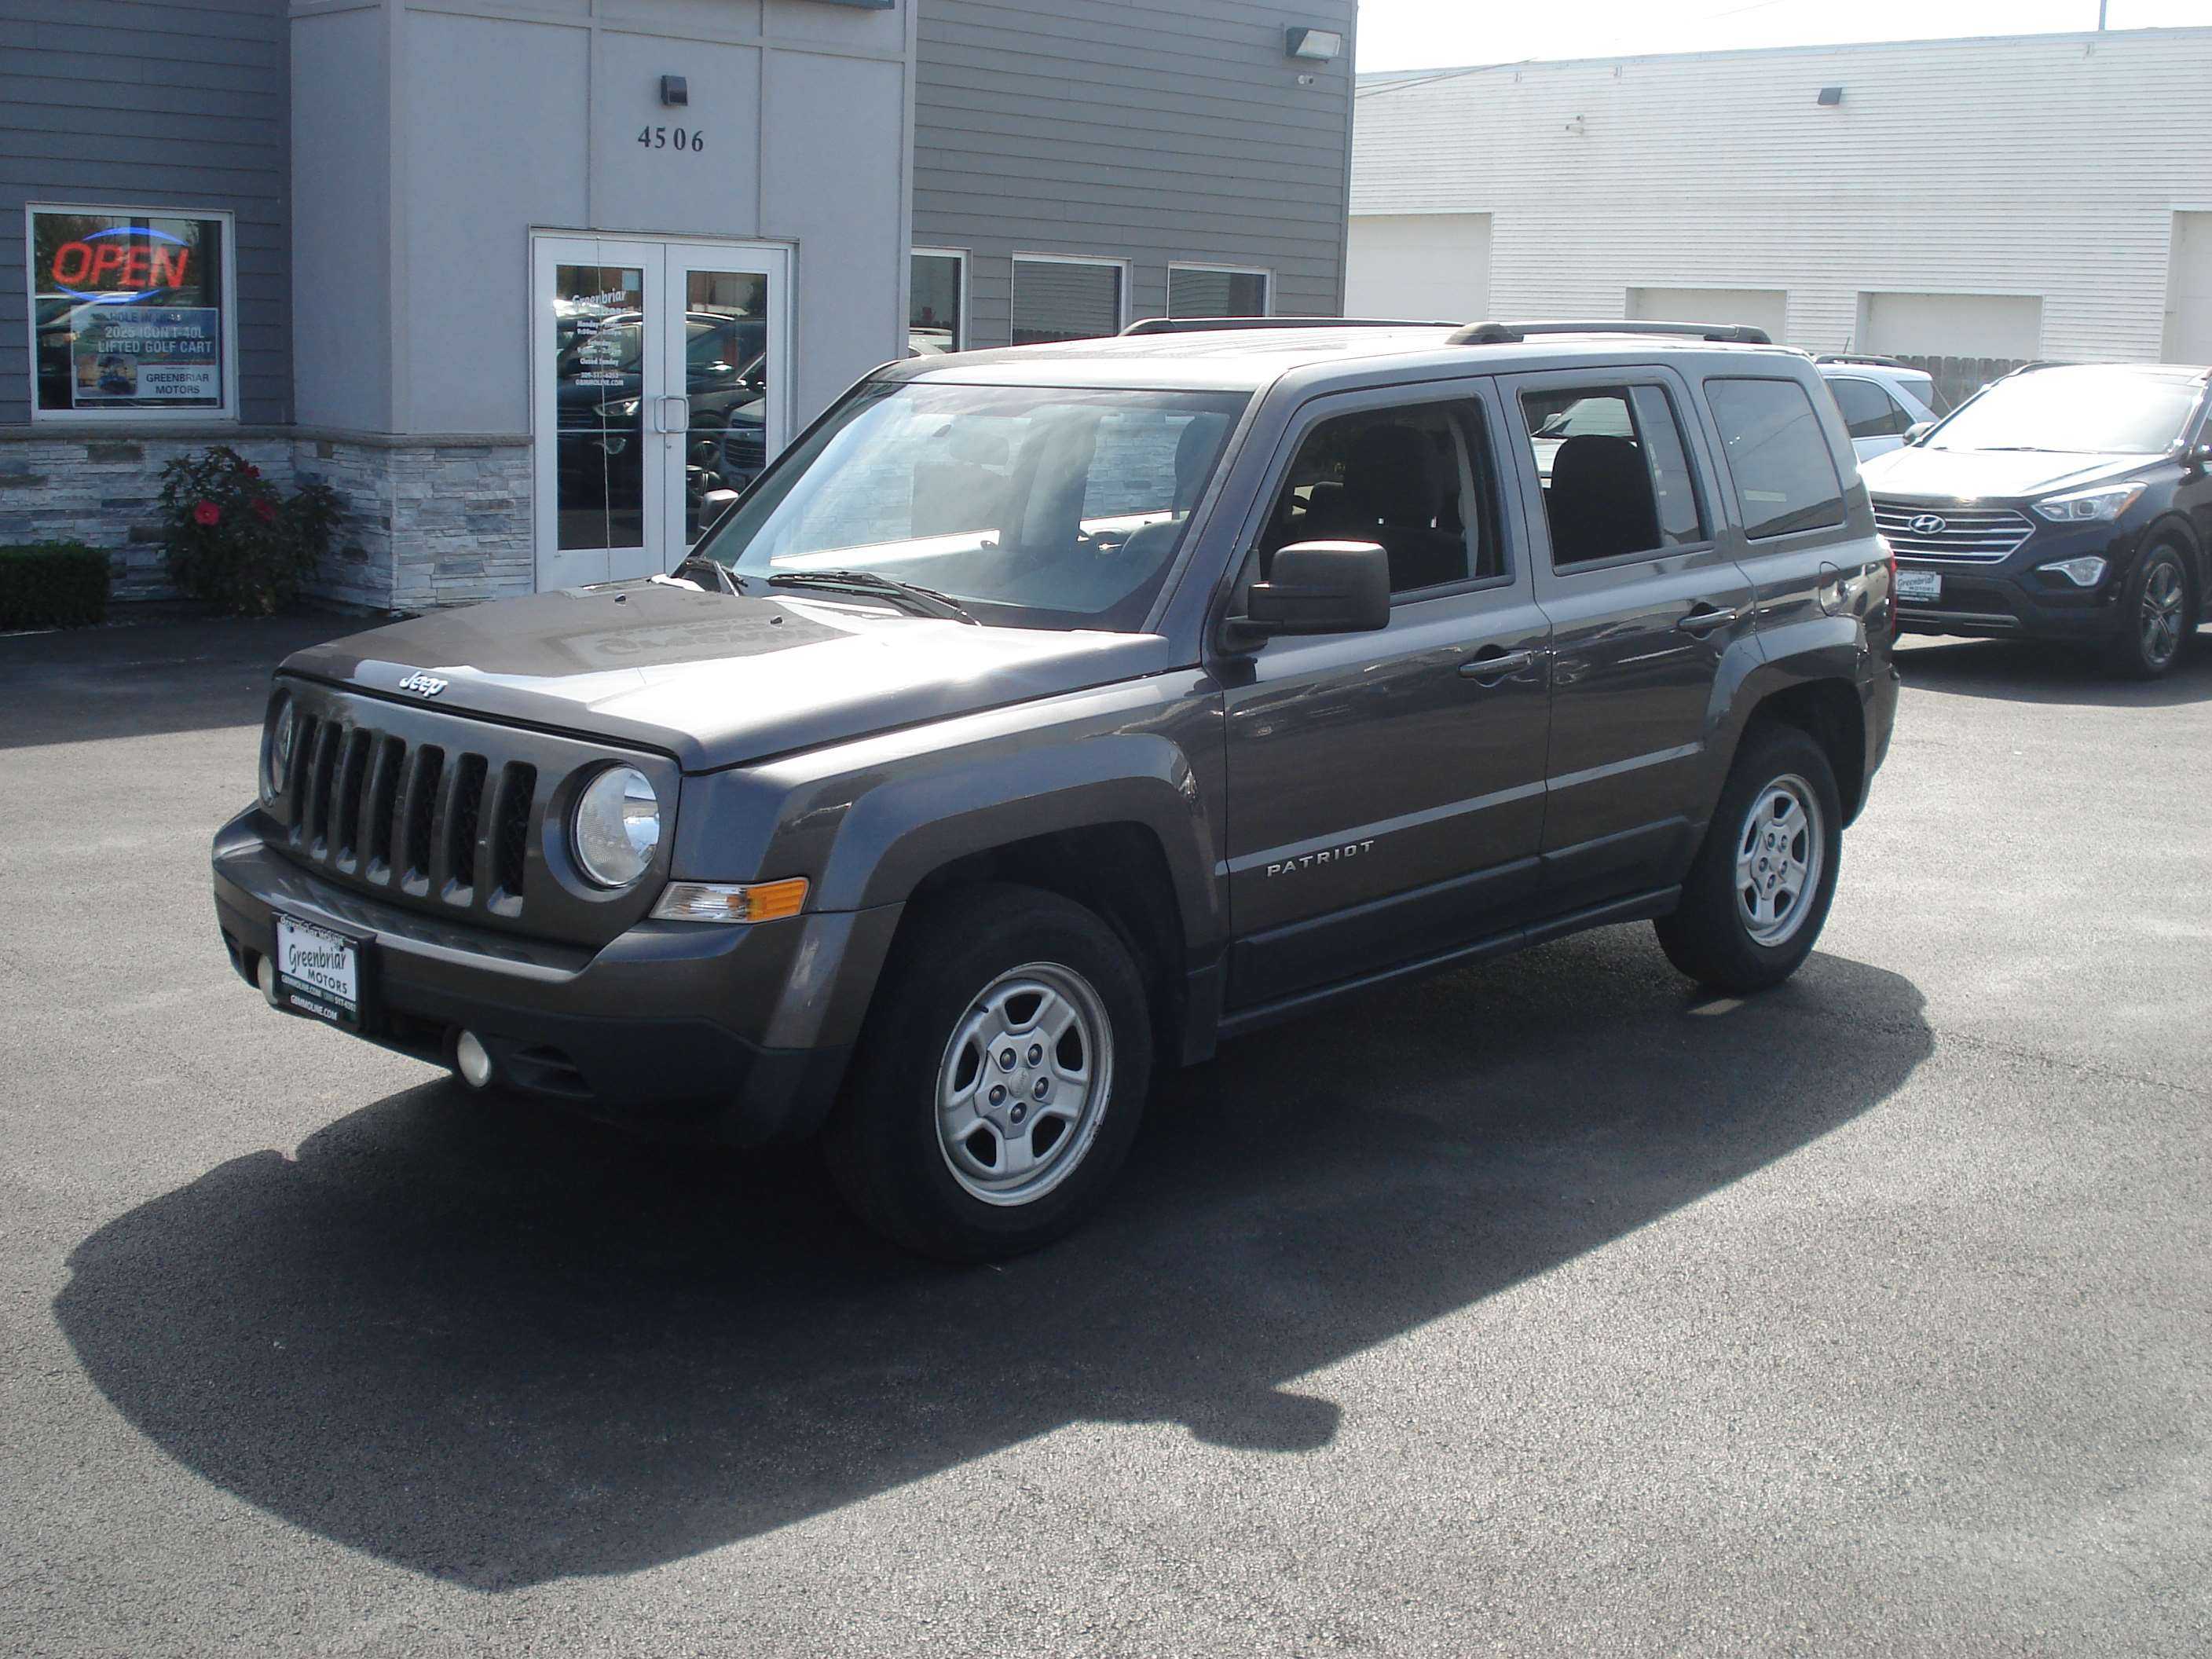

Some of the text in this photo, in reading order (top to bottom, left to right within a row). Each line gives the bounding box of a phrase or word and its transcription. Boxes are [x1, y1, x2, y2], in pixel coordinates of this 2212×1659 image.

[637, 125, 704, 152] 4506
[52, 240, 189, 289] OPEN
[104, 326, 134, 339] 2025
[97, 340, 212, 353] LIFTED GOLF CART
[145, 373, 210, 383] GREENBRIAR
[155, 385, 200, 394] MOTORS
[399, 671, 449, 698] Jeep
[1266, 840, 1375, 877] PATRIOT
[288, 943, 346, 974] Greenbriar
[308, 969, 348, 994] MOTORS
